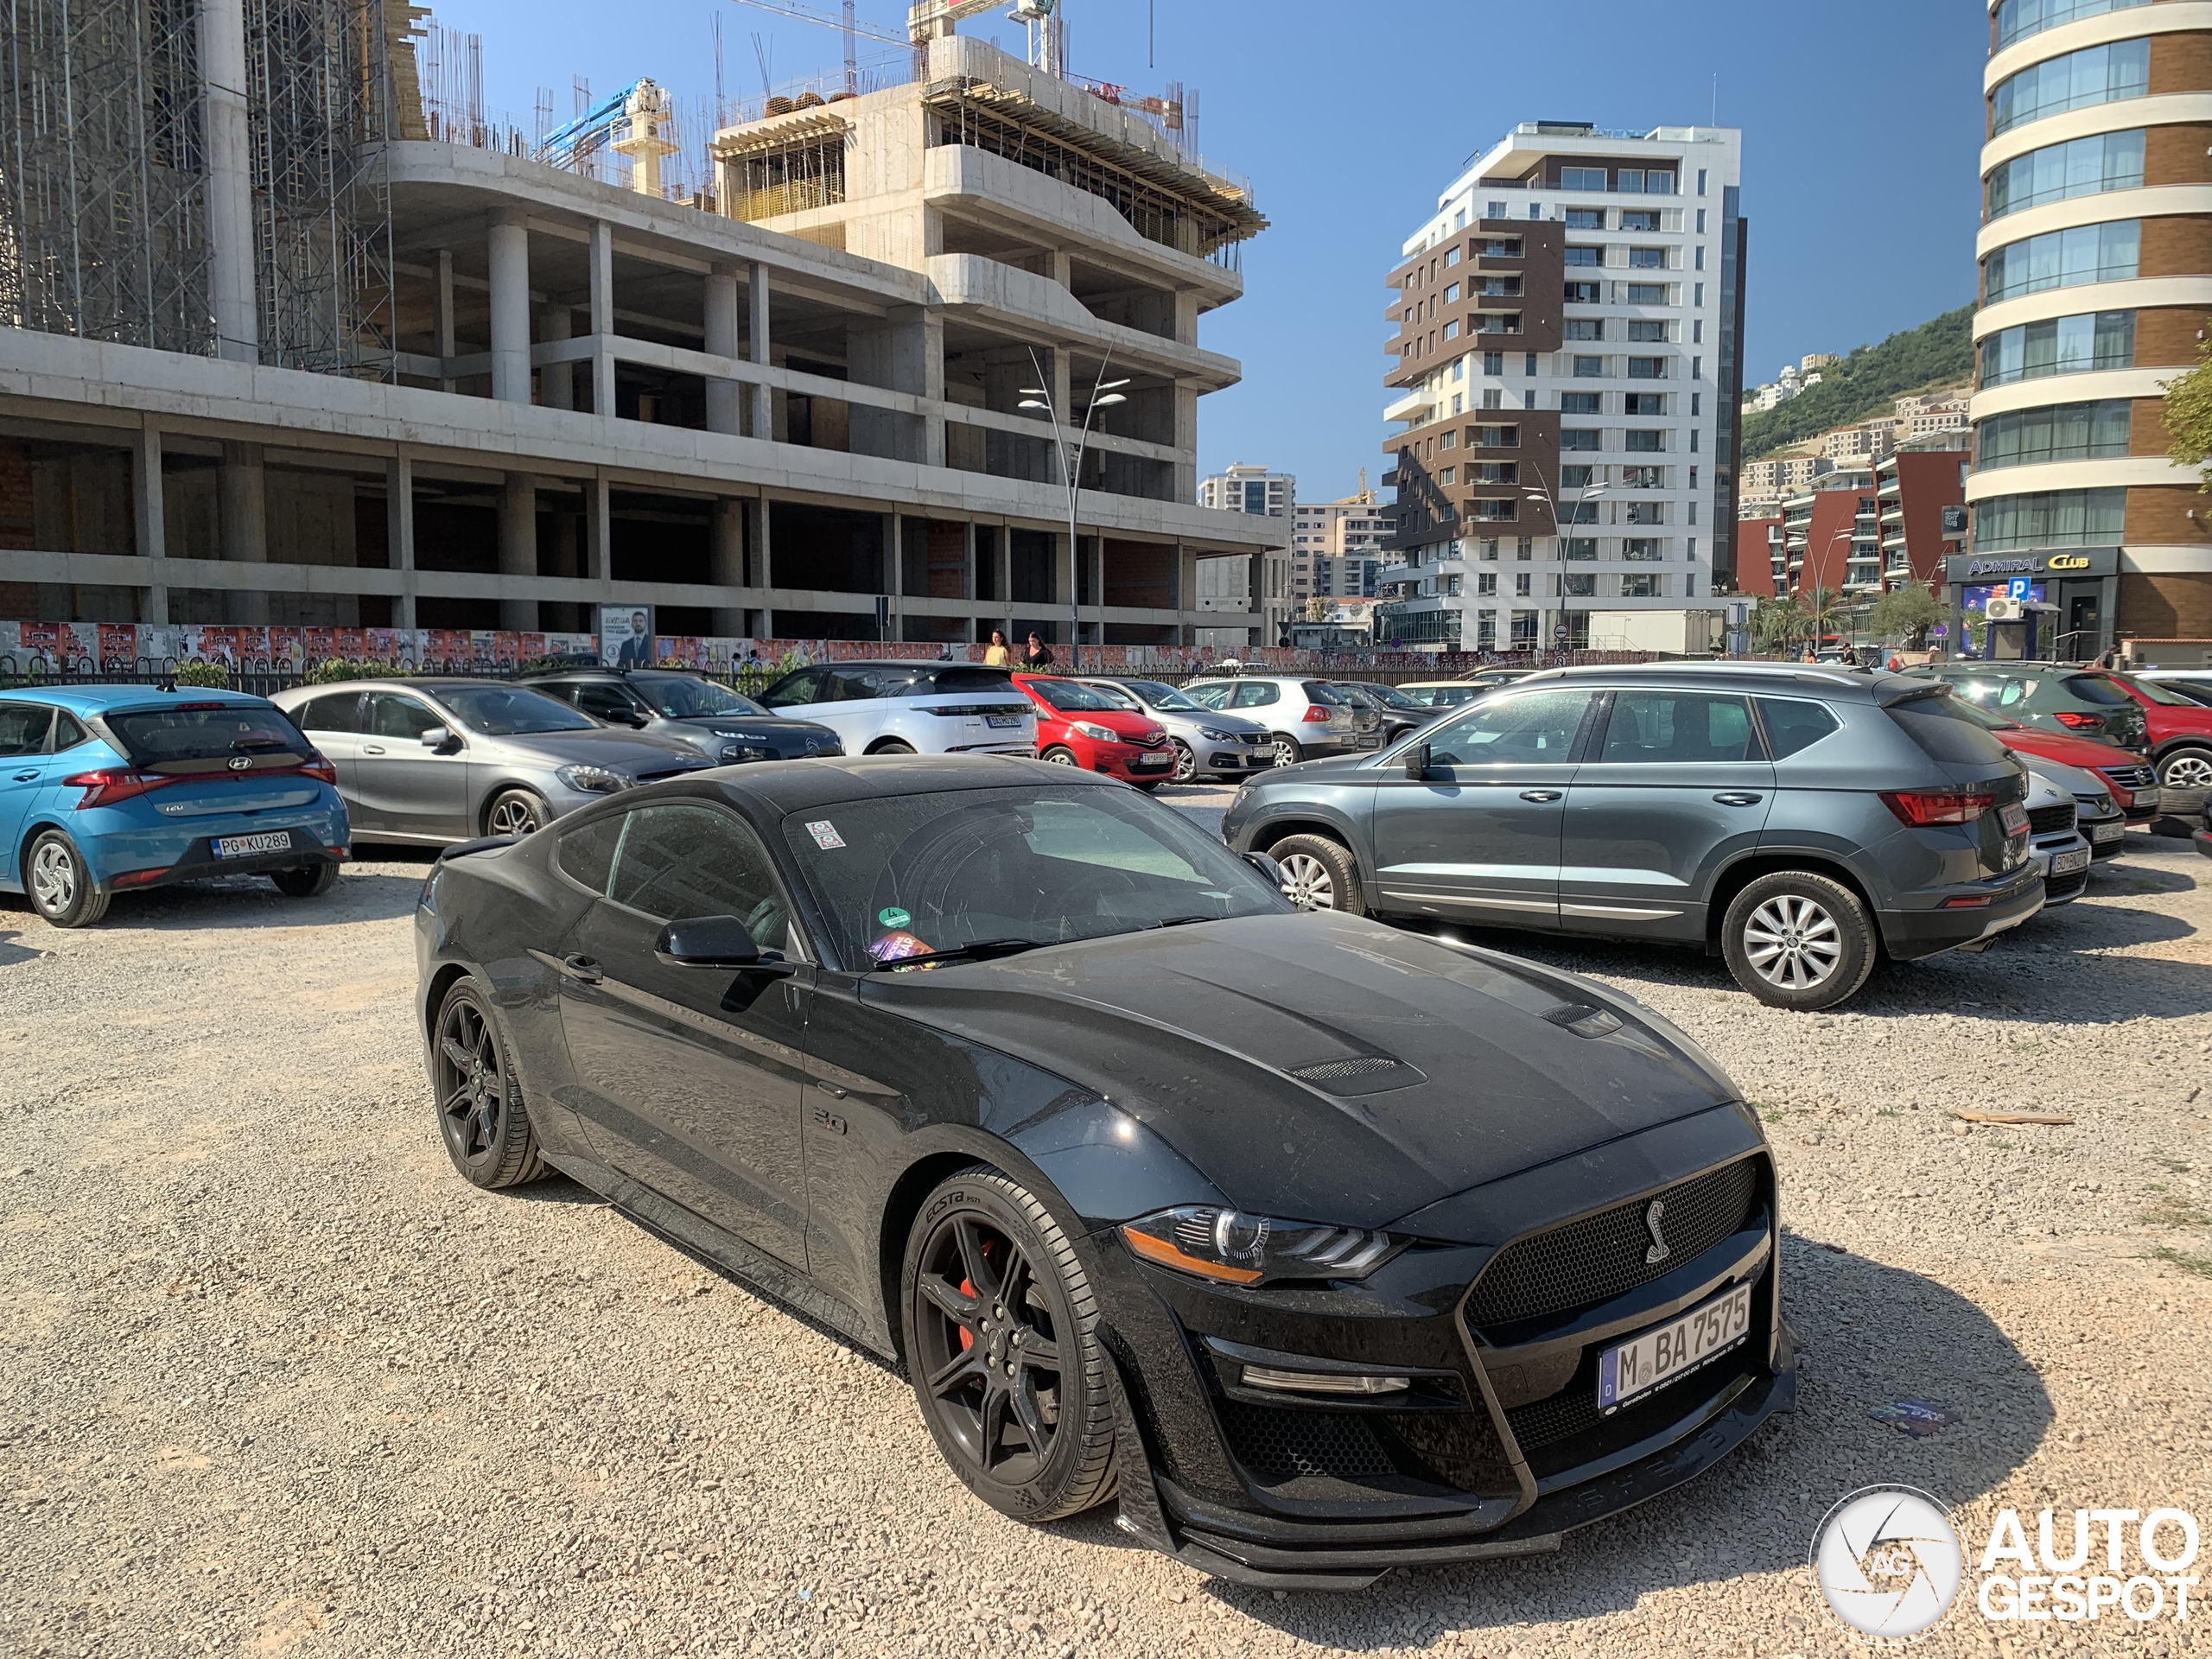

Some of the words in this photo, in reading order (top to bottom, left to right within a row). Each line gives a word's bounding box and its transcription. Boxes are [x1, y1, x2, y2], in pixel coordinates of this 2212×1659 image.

[1968, 557, 2044, 575] ADMIRAL
[2049, 554, 2089, 569] CLUB
[221, 839, 240, 854] PG
[246, 834, 289, 851] KU289
[1789, 883, 1835, 906] Continental
[883, 936, 905, 961] COCKTAIL
[896, 938, 916, 957] BAR
[1749, 978, 1793, 1002] Continental
[1619, 1344, 1638, 1392] M
[1656, 1323, 1688, 1376] BA
[1694, 1288, 1747, 1356] 7575
[1605, 1383, 1612, 1397] D
[928, 1419, 976, 1489] KUMHO
